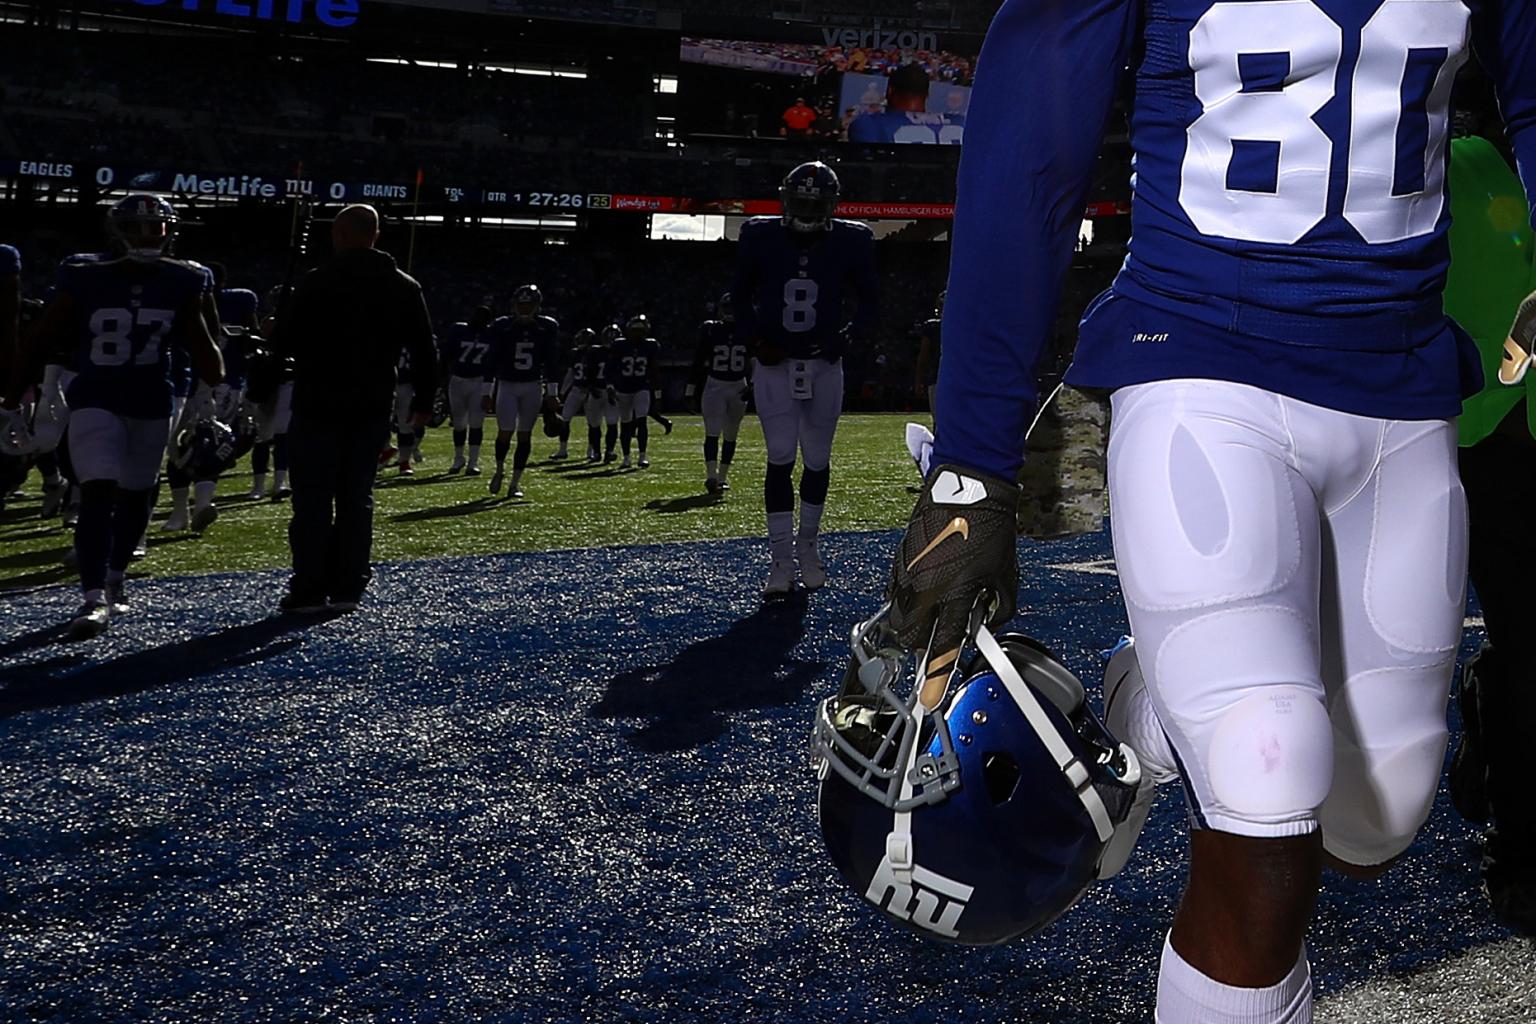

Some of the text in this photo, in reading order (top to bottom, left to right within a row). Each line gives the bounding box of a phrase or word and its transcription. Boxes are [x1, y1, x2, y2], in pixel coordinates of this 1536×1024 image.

[821, 17, 937, 52] verizon
[19, 160, 74, 178] EAGLES
[96, 166, 115, 186] 0
[172, 173, 278, 198] MetLife
[329, 182, 347, 200] 0
[363, 183, 408, 199] GIANTS
[527, 192, 583, 208] 27:26
[592, 195, 609, 207] 25
[782, 278, 820, 333] 8
[88, 307, 176, 367] 87
[458, 340, 490, 365] 77
[513, 341, 536, 370] 5
[712, 343, 748, 373] 26
[621, 355, 648, 377] 33
